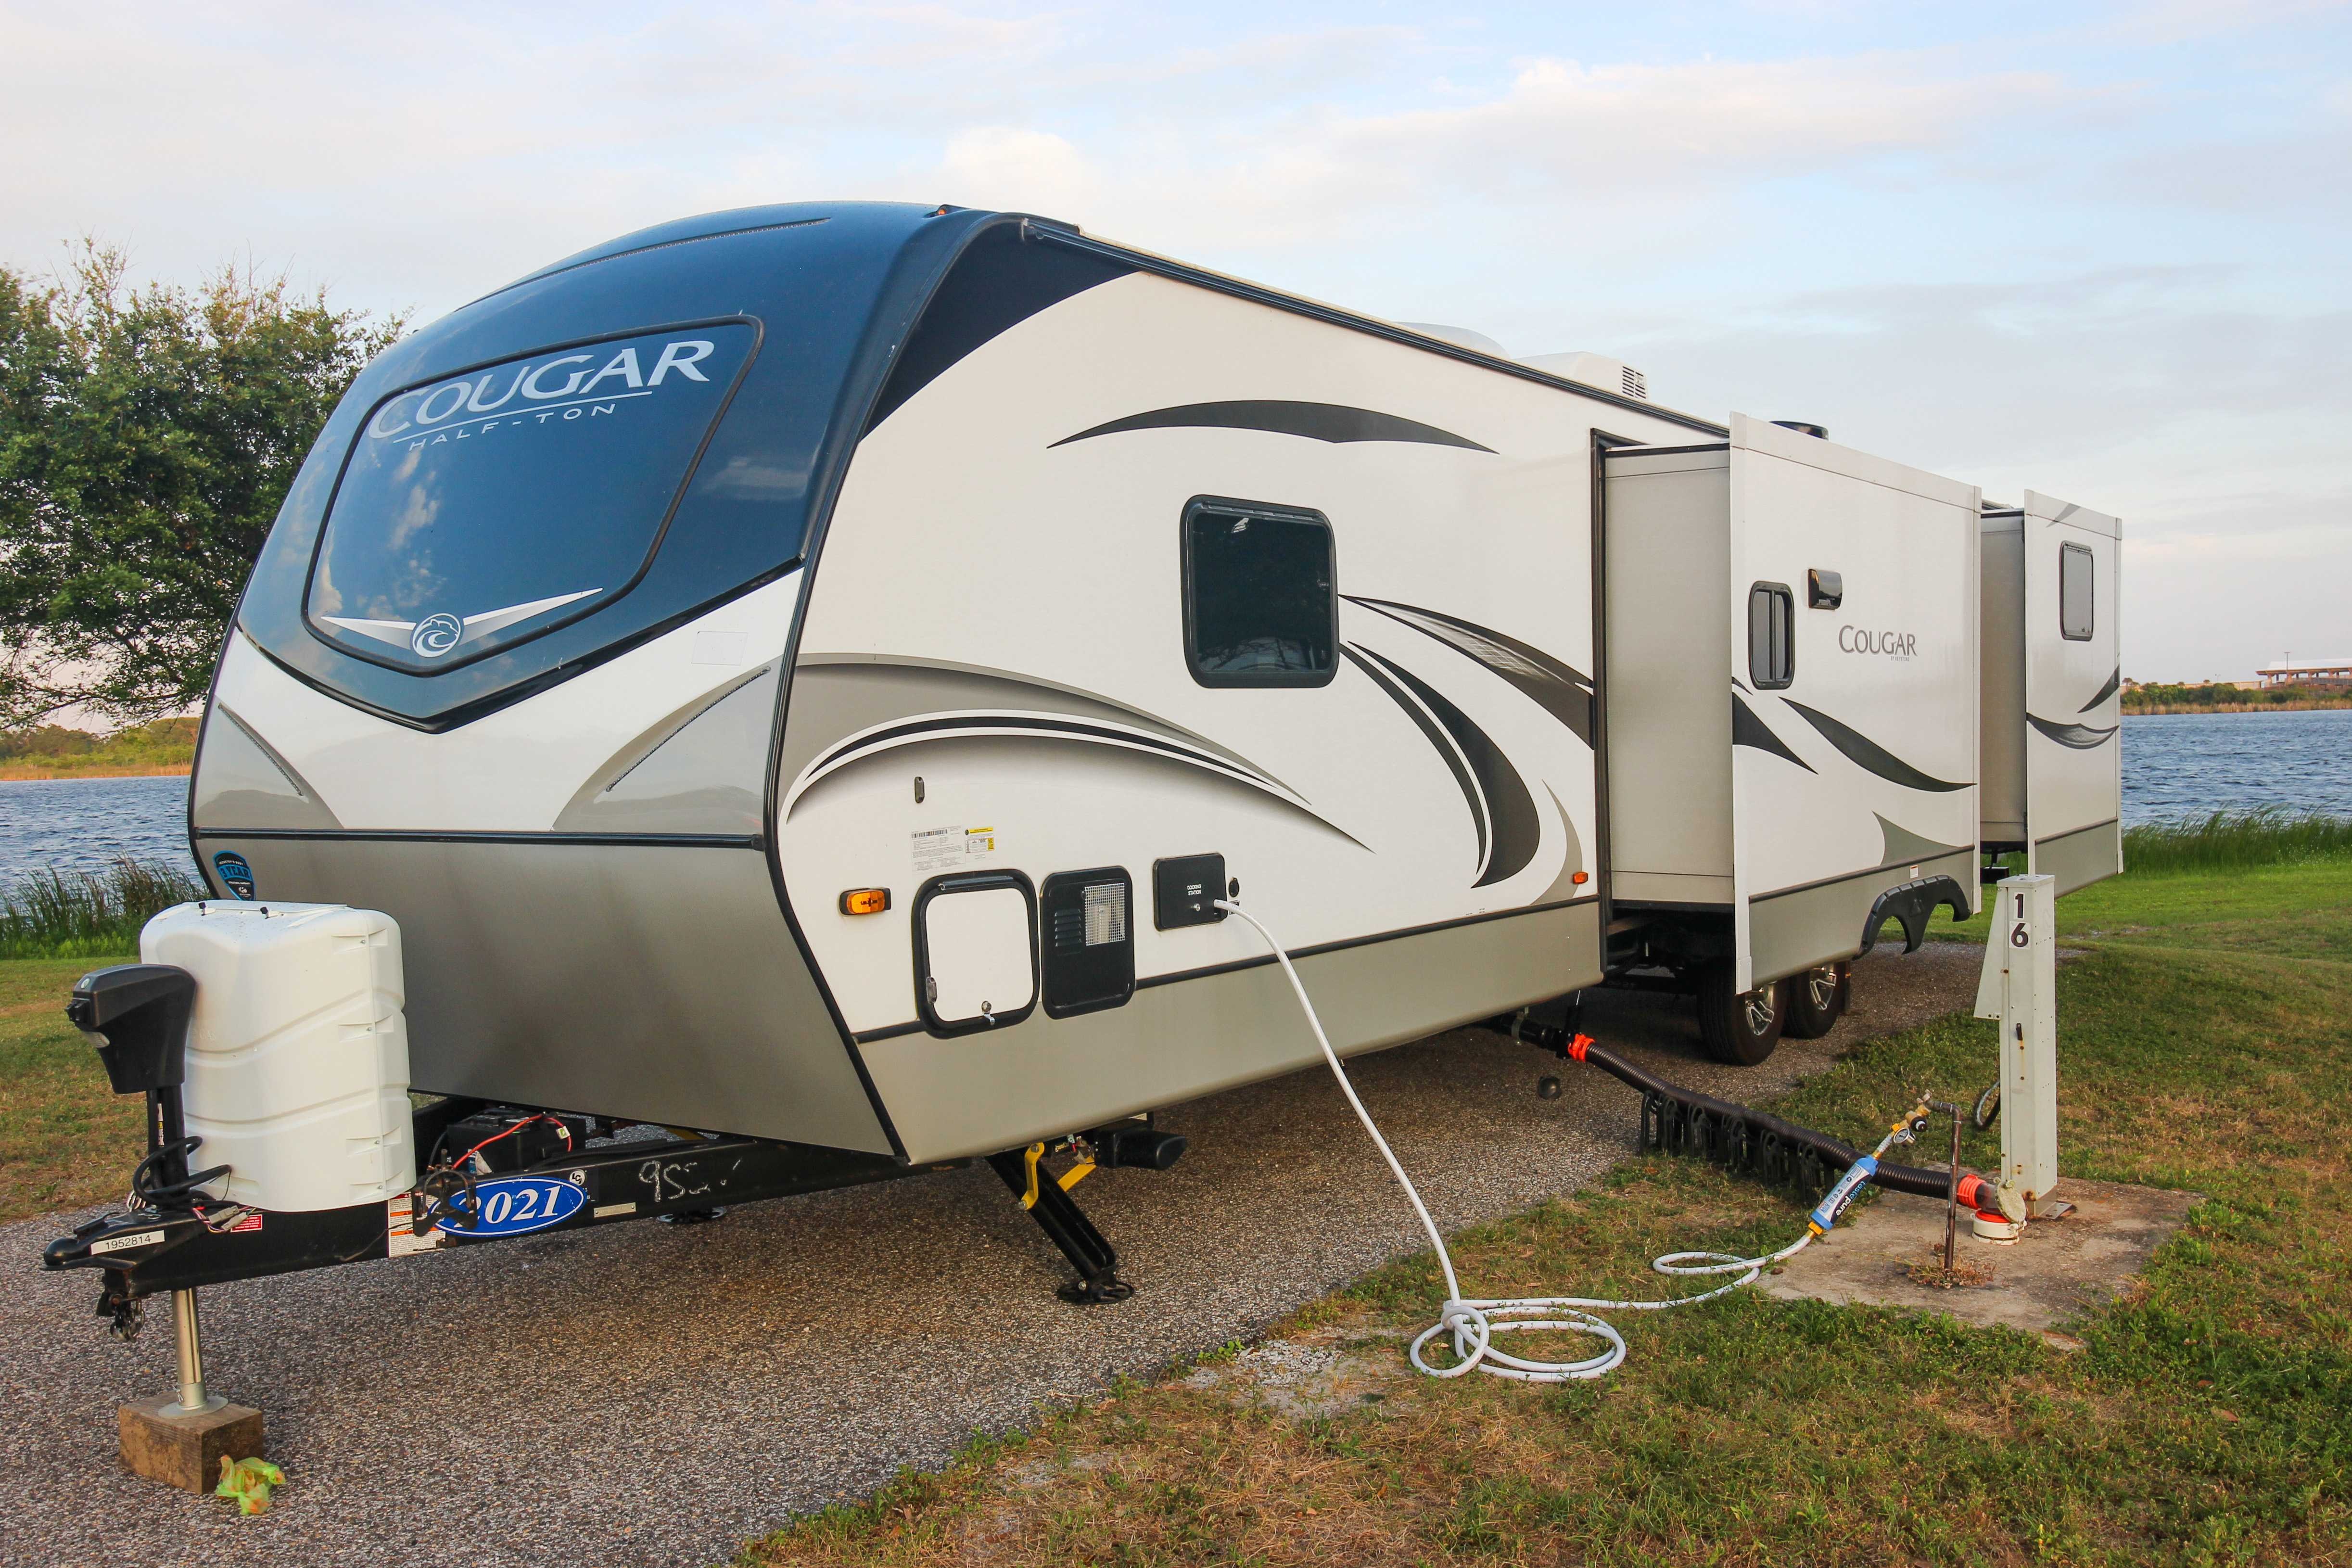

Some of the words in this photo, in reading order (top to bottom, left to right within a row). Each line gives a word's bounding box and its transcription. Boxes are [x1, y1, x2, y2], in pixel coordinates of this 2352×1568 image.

[368, 340, 715, 439] COUGAR
[408, 403, 616, 451] HALF-TON
[226, 867, 250, 880] YEAR
[106, 1234, 152, 1249] 1952814
